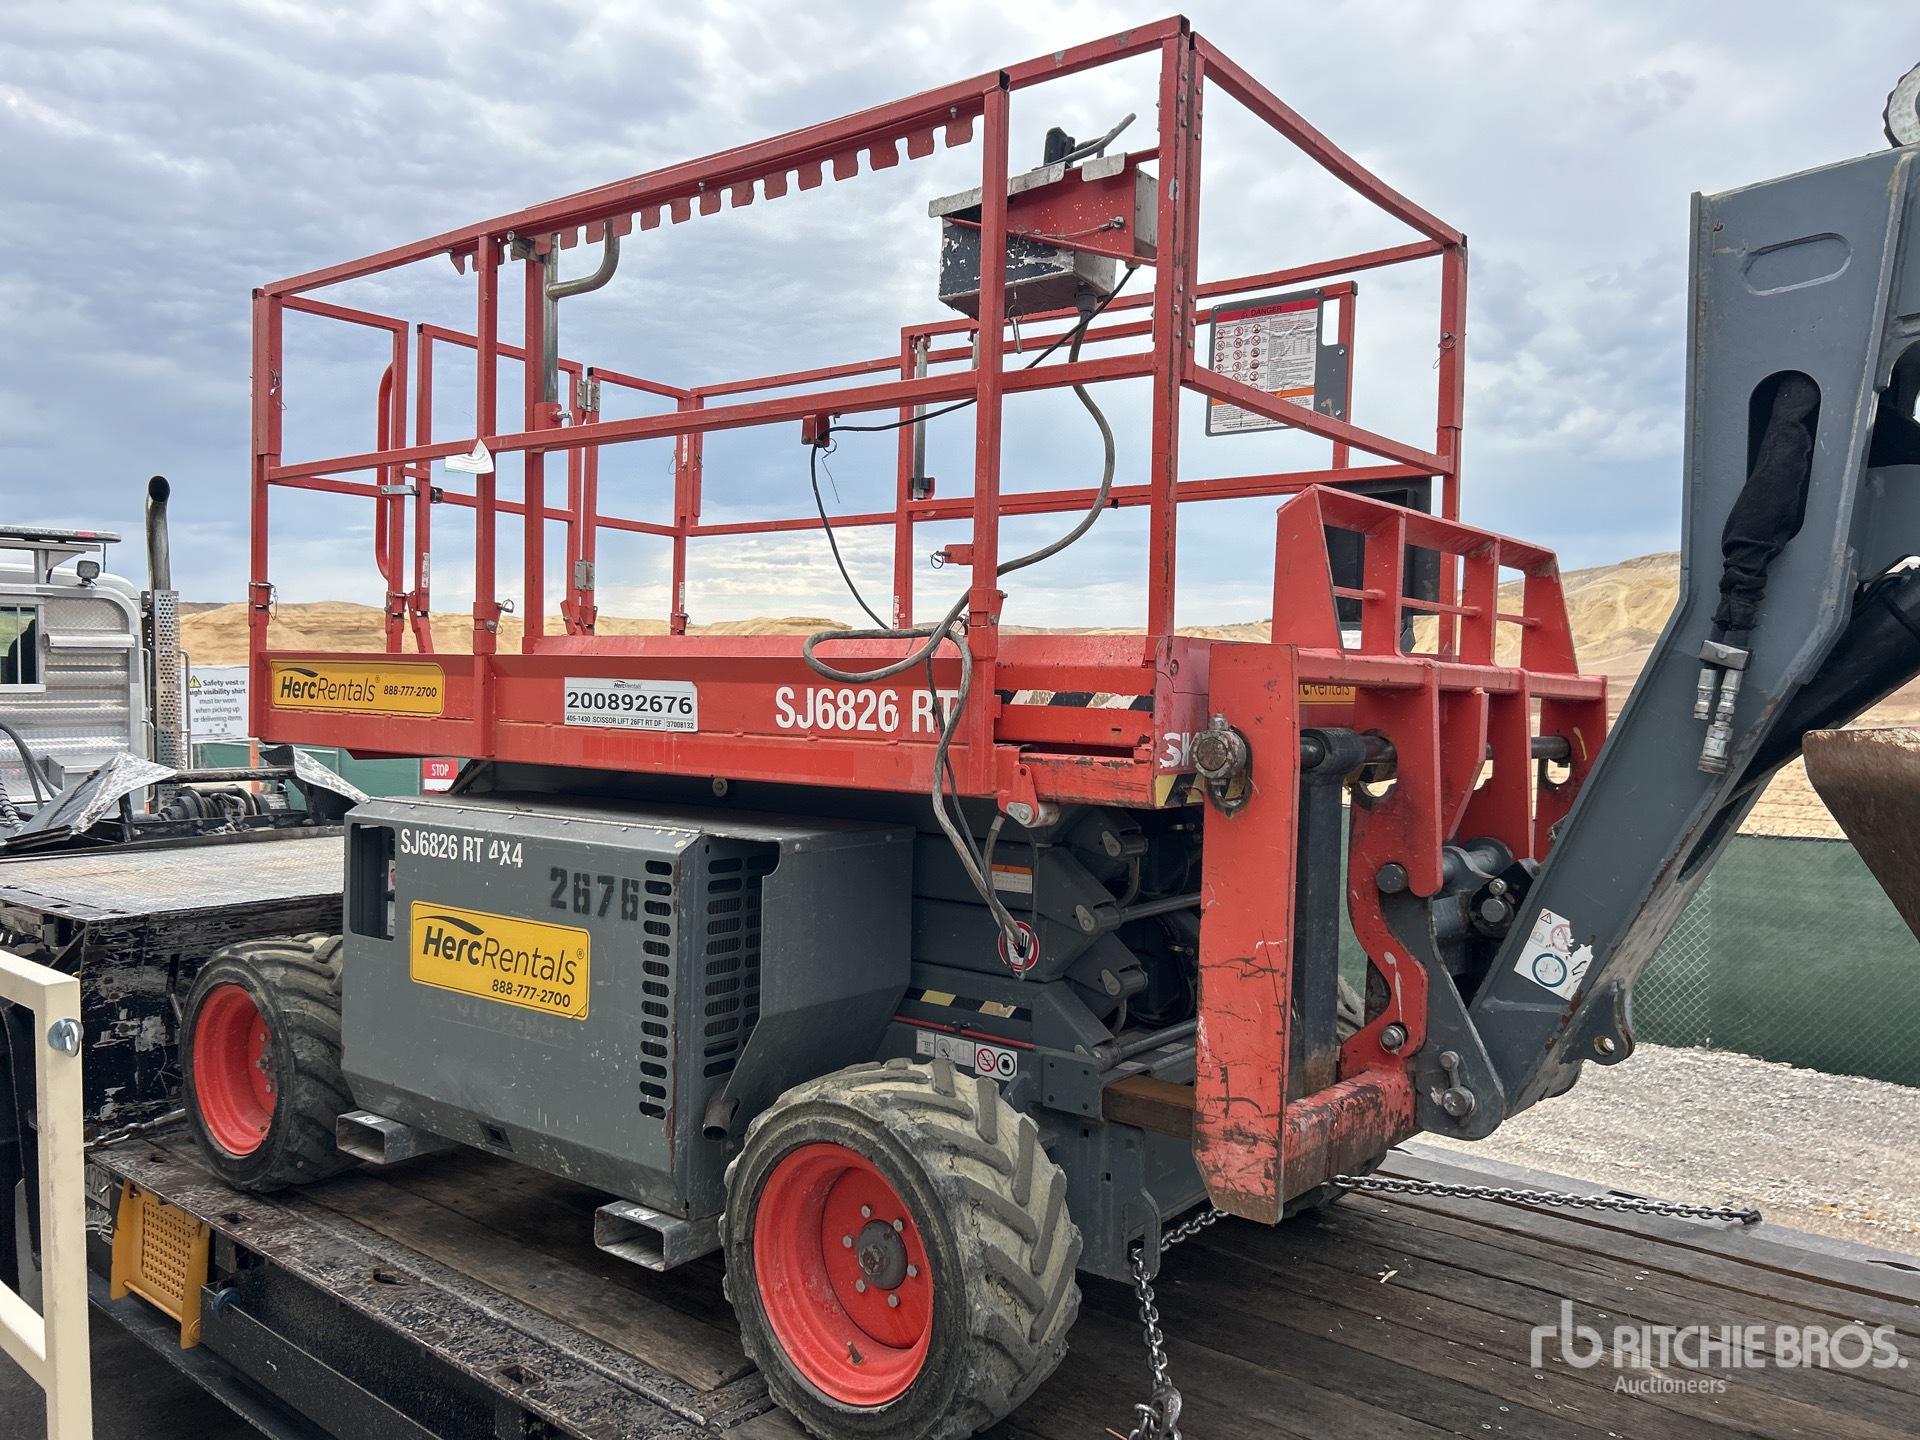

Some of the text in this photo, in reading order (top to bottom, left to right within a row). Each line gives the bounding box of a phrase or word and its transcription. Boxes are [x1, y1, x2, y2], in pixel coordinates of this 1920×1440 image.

[1251, 306, 1282, 316] DANGER
[203, 688, 230, 696] visibility
[280, 676, 437, 702] HercRentals 888-777-2700
[567, 692, 693, 714] 200892676
[775, 686, 961, 733] SJ6826 RT
[566, 715, 591, 723] 405-1430
[592, 716, 617, 724] SCISSOR
[617, 717, 630, 725] LIFT
[630, 718, 644, 726] 26FT
[654, 719, 662, 727] DF
[666, 720, 694, 729] 37008132
[431, 763, 450, 777] STOP
[400, 828, 524, 868] SJ6826 RT 4X4
[550, 867, 640, 921] 2676
[422, 926, 577, 986] HercRentals
[491, 979, 571, 1008] 888-777-2700
